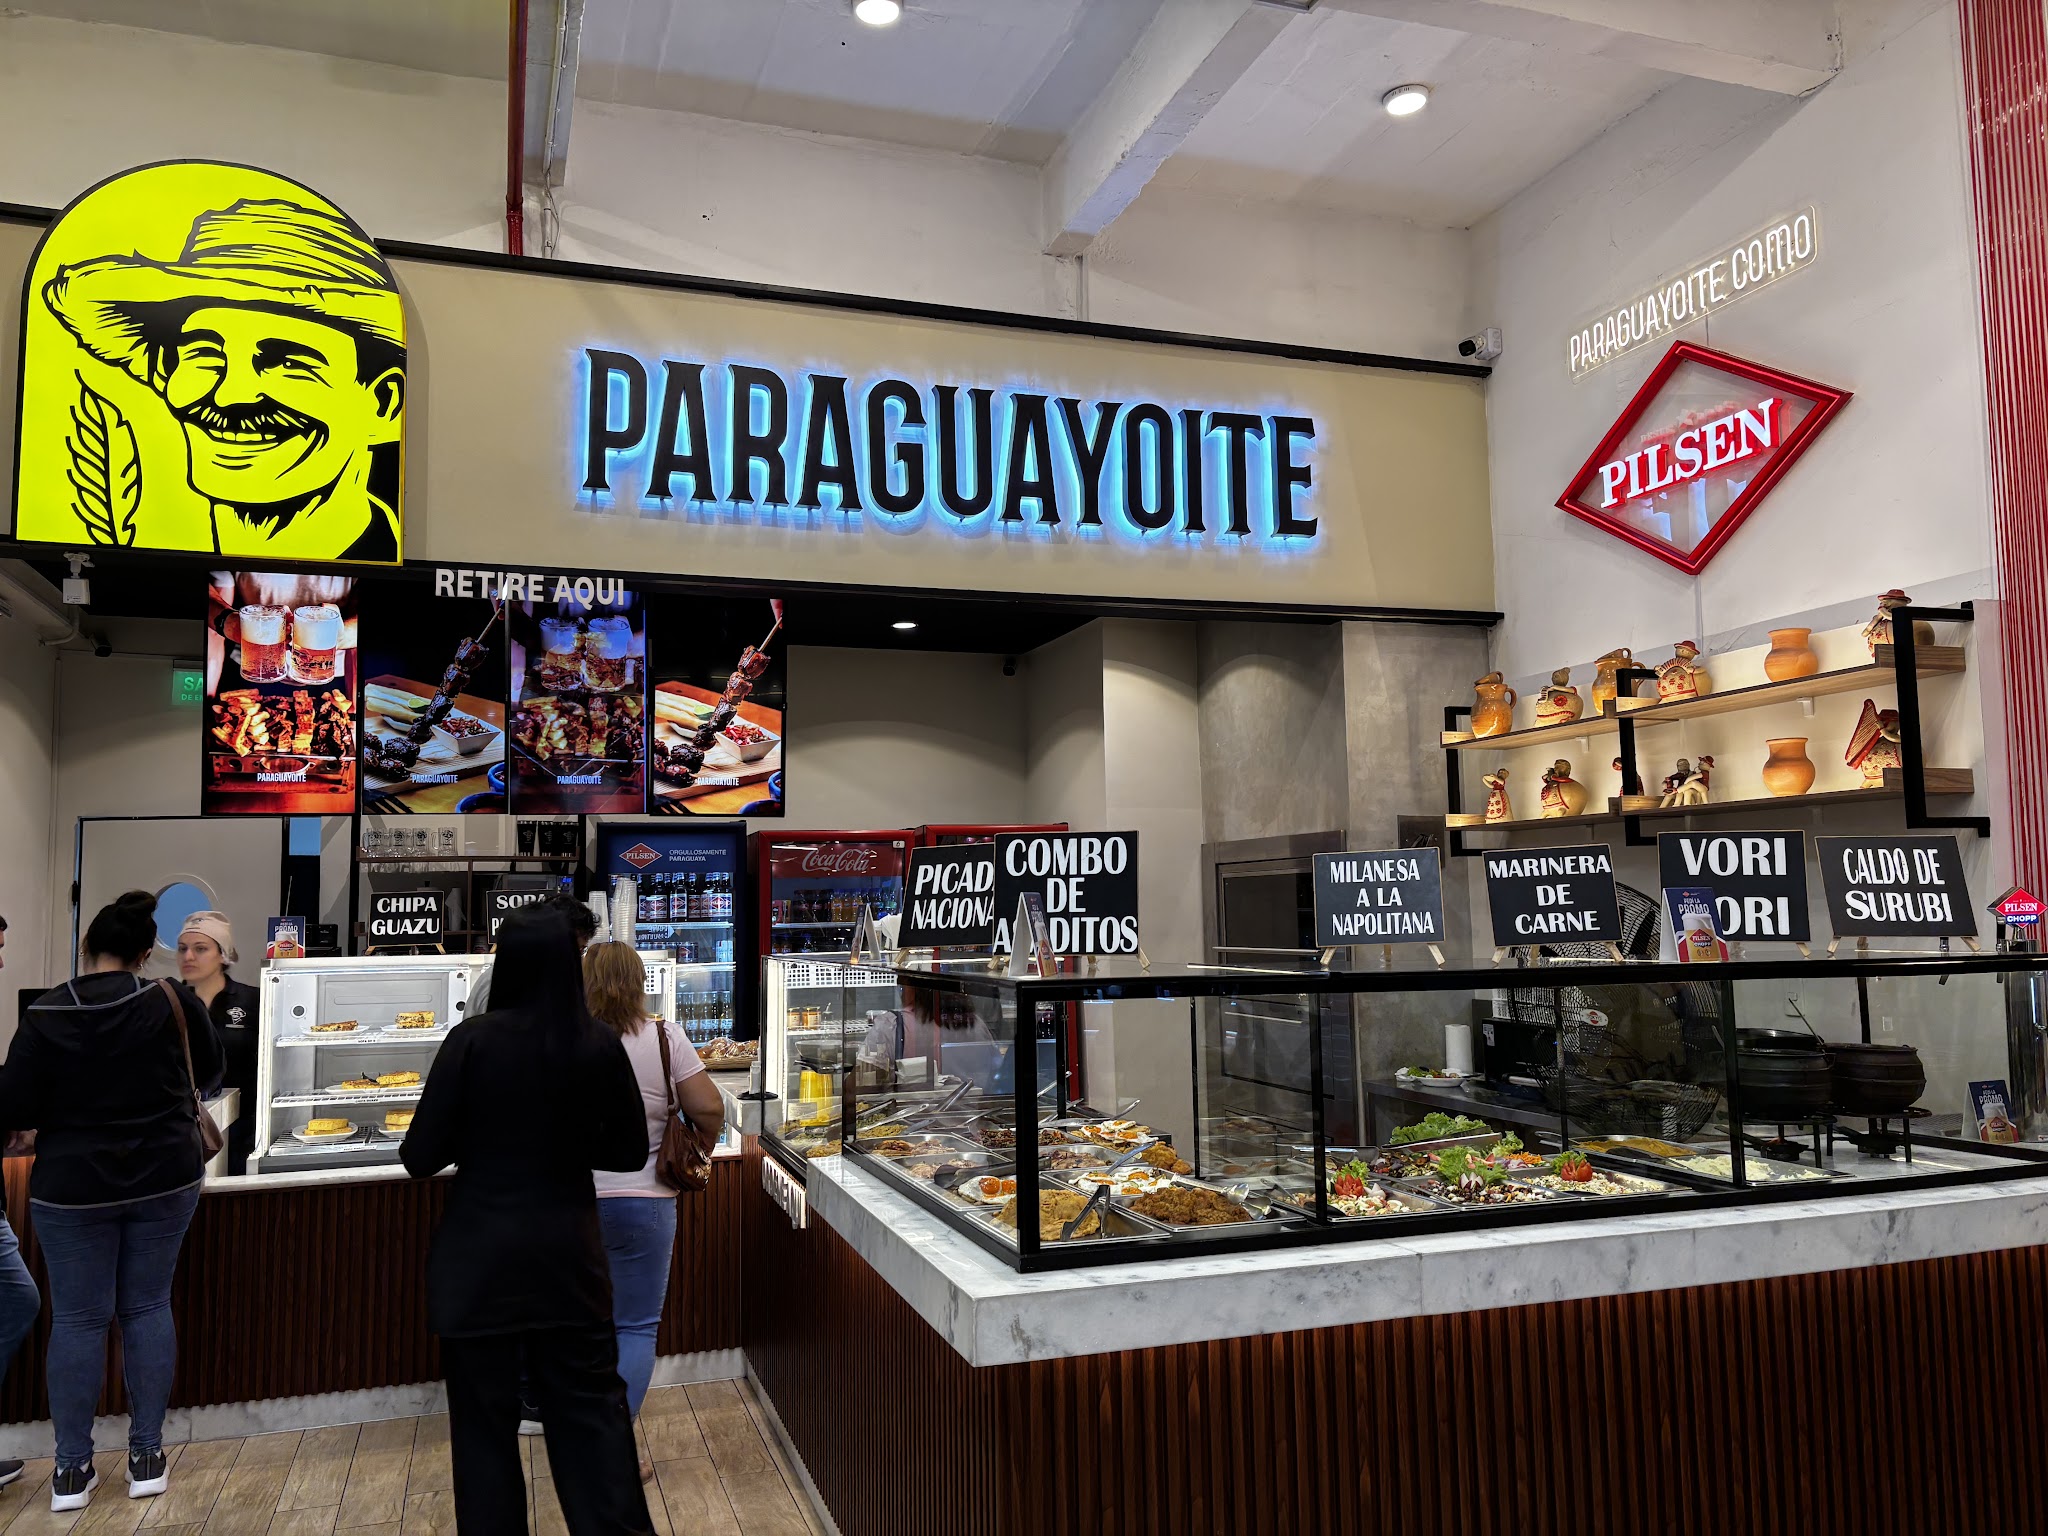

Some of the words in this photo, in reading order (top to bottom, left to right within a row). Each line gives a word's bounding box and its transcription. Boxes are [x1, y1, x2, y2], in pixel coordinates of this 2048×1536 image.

[1570, 261, 1725, 371] PARAGUAYOITE
[1732, 215, 1811, 290] COMO
[582, 348, 1318, 538] PARAGUAYOITE
[1599, 398, 1779, 508] PILSEN
[435, 568, 545, 602] RETIRE
[552, 576, 625, 610] AQUI
[257, 773, 307, 782] PARAGUAYOITE
[412, 774, 458, 783] PARAGUAYOITE
[557, 775, 602, 785] PARAGUAYOITE
[697, 777, 739, 786] PARAGUAYOITE
[626, 852, 656, 860] PILSEN
[1006, 836, 1128, 877] COMBO
[1488, 854, 1611, 879] MARINERA
[1679, 837, 1787, 876] VORI
[1842, 847, 1909, 885] CALDO
[1912, 848, 1946, 885] DE
[914, 861, 993, 895] PICAD
[1330, 858, 1421, 883] MILANESA
[376, 896, 438, 913] CHIPA
[1047, 877, 1086, 913] DE
[1356, 887, 1370, 907] A
[1377, 887, 1403, 907] LA
[1536, 883, 1574, 907] DE
[1845, 890, 1953, 923] SURUBI
[2004, 902, 2038, 912] PILSEN
[1678, 903, 1710, 914] PROMO
[1715, 896, 1790, 936] ORI
[2006, 914, 2037, 922] CHOPP
[371, 917, 440, 936] GUAZU
[992, 915, 1138, 954] ADITOS
[1332, 911, 1435, 936] NAPOLITANA
[1515, 910, 1600, 935] CARNE
